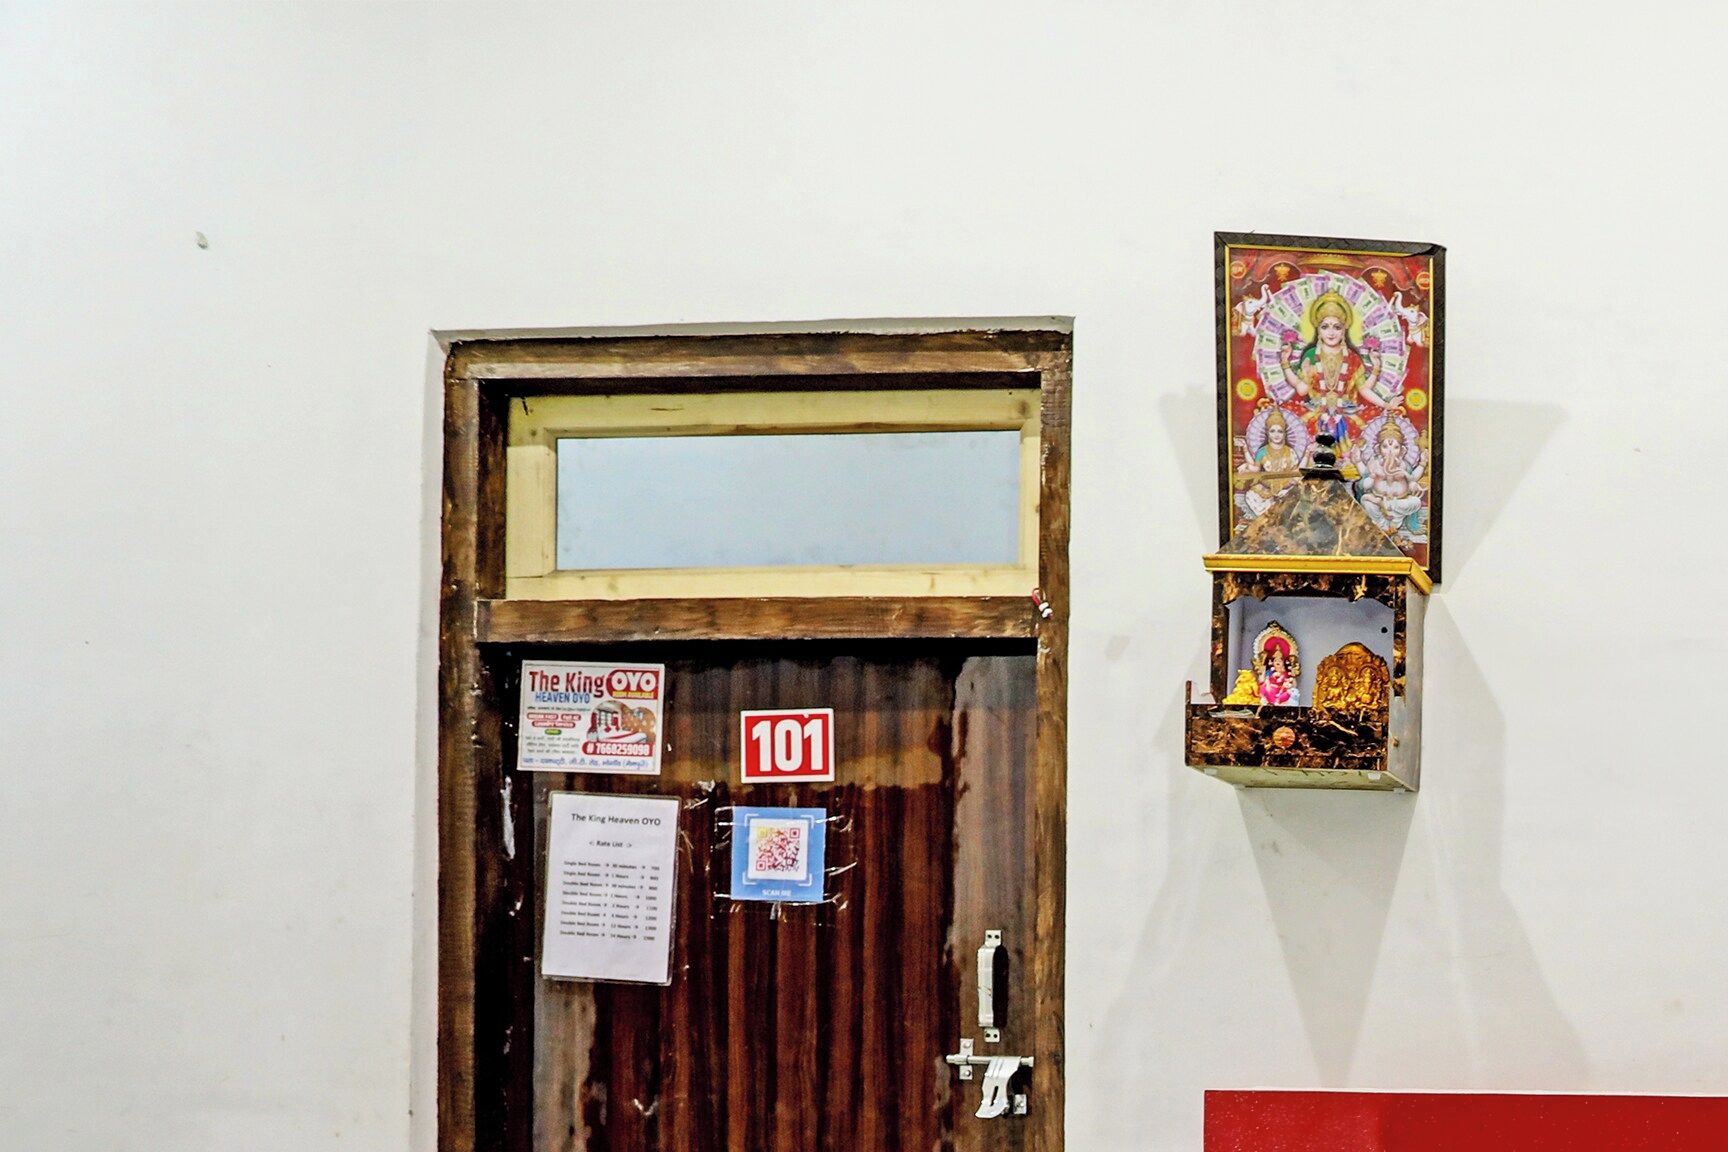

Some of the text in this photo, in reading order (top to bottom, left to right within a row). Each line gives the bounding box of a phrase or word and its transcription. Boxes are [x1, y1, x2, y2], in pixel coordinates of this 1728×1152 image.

[529, 670, 656, 698] The King OYO
[535, 692, 590, 703] HEAVEN OYO
[752, 718, 823, 772] 101
[588, 814, 606, 824] King
[608, 816, 639, 824] Heaven
[642, 817, 661, 826] OYO
